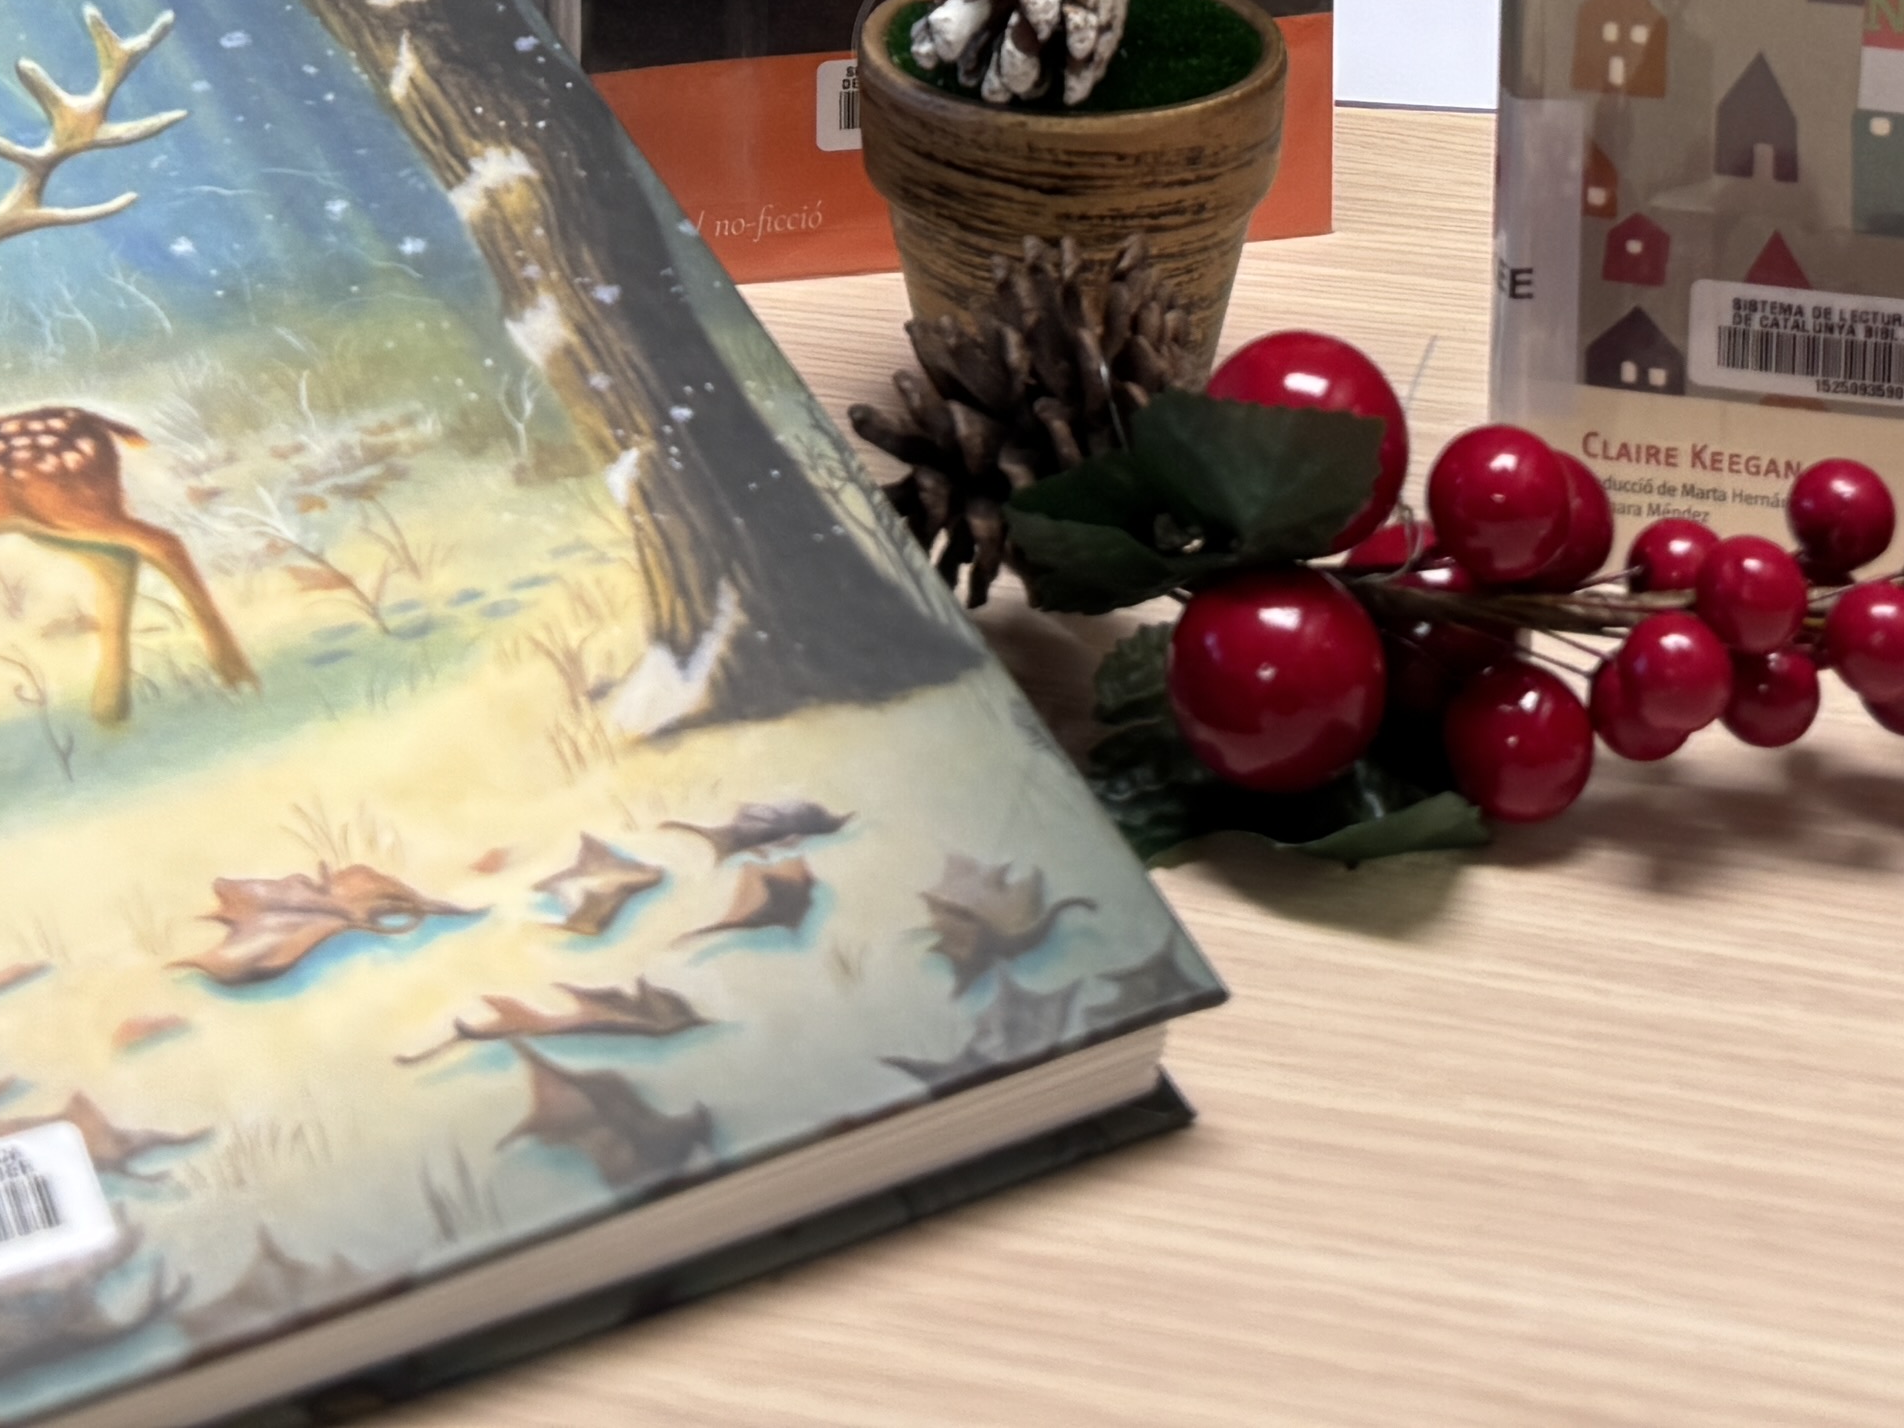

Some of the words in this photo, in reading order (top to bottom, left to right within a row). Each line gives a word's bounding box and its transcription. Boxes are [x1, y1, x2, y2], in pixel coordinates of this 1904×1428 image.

[715, 199, 823, 243] no-ficció
[1732, 297, 1805, 318] SISTEMA
[1812, 305, 1833, 321] DE
[1732, 313, 1752, 329] DE
[1759, 315, 1857, 337] CATALUNYA
[1656, 481, 1679, 497] de
[1681, 483, 1728, 503] Marta
